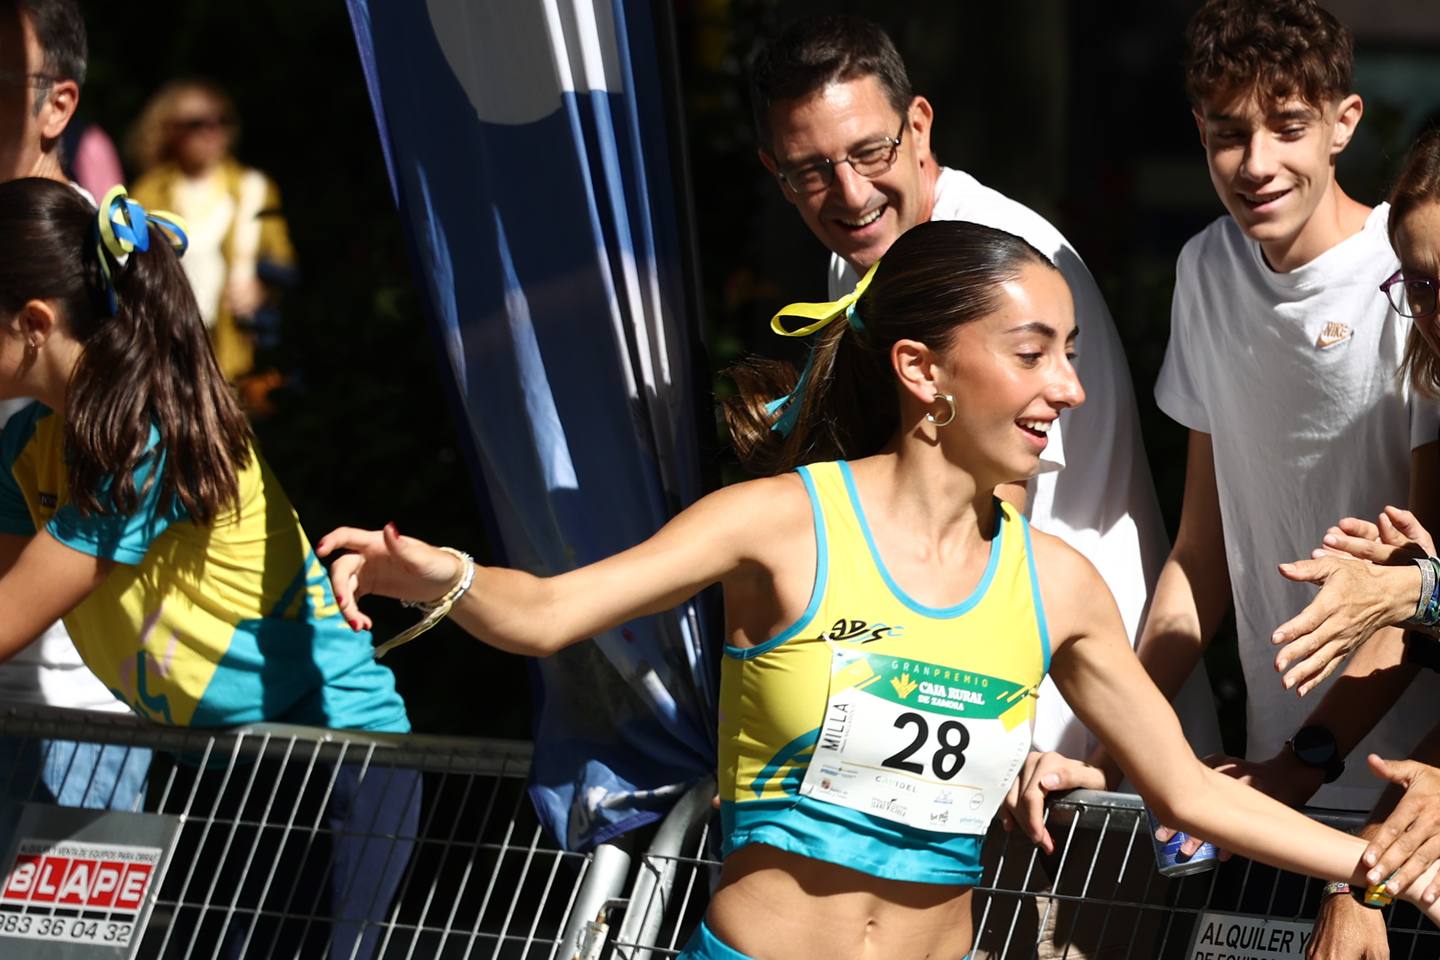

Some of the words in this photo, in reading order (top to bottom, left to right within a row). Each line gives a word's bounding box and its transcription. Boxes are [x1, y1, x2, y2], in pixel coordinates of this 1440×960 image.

[947, 686, 986, 705] RURAL
[820, 703, 849, 751] MILLA
[881, 712, 971, 781] 28
[7, 861, 148, 901] BLAPE
[37, 918, 66, 936] 36
[70, 921, 97, 939] 04
[103, 924, 132, 943] 32
[1200, 922, 1294, 954] ALQUILER
[1298, 931, 1312, 954] Y
